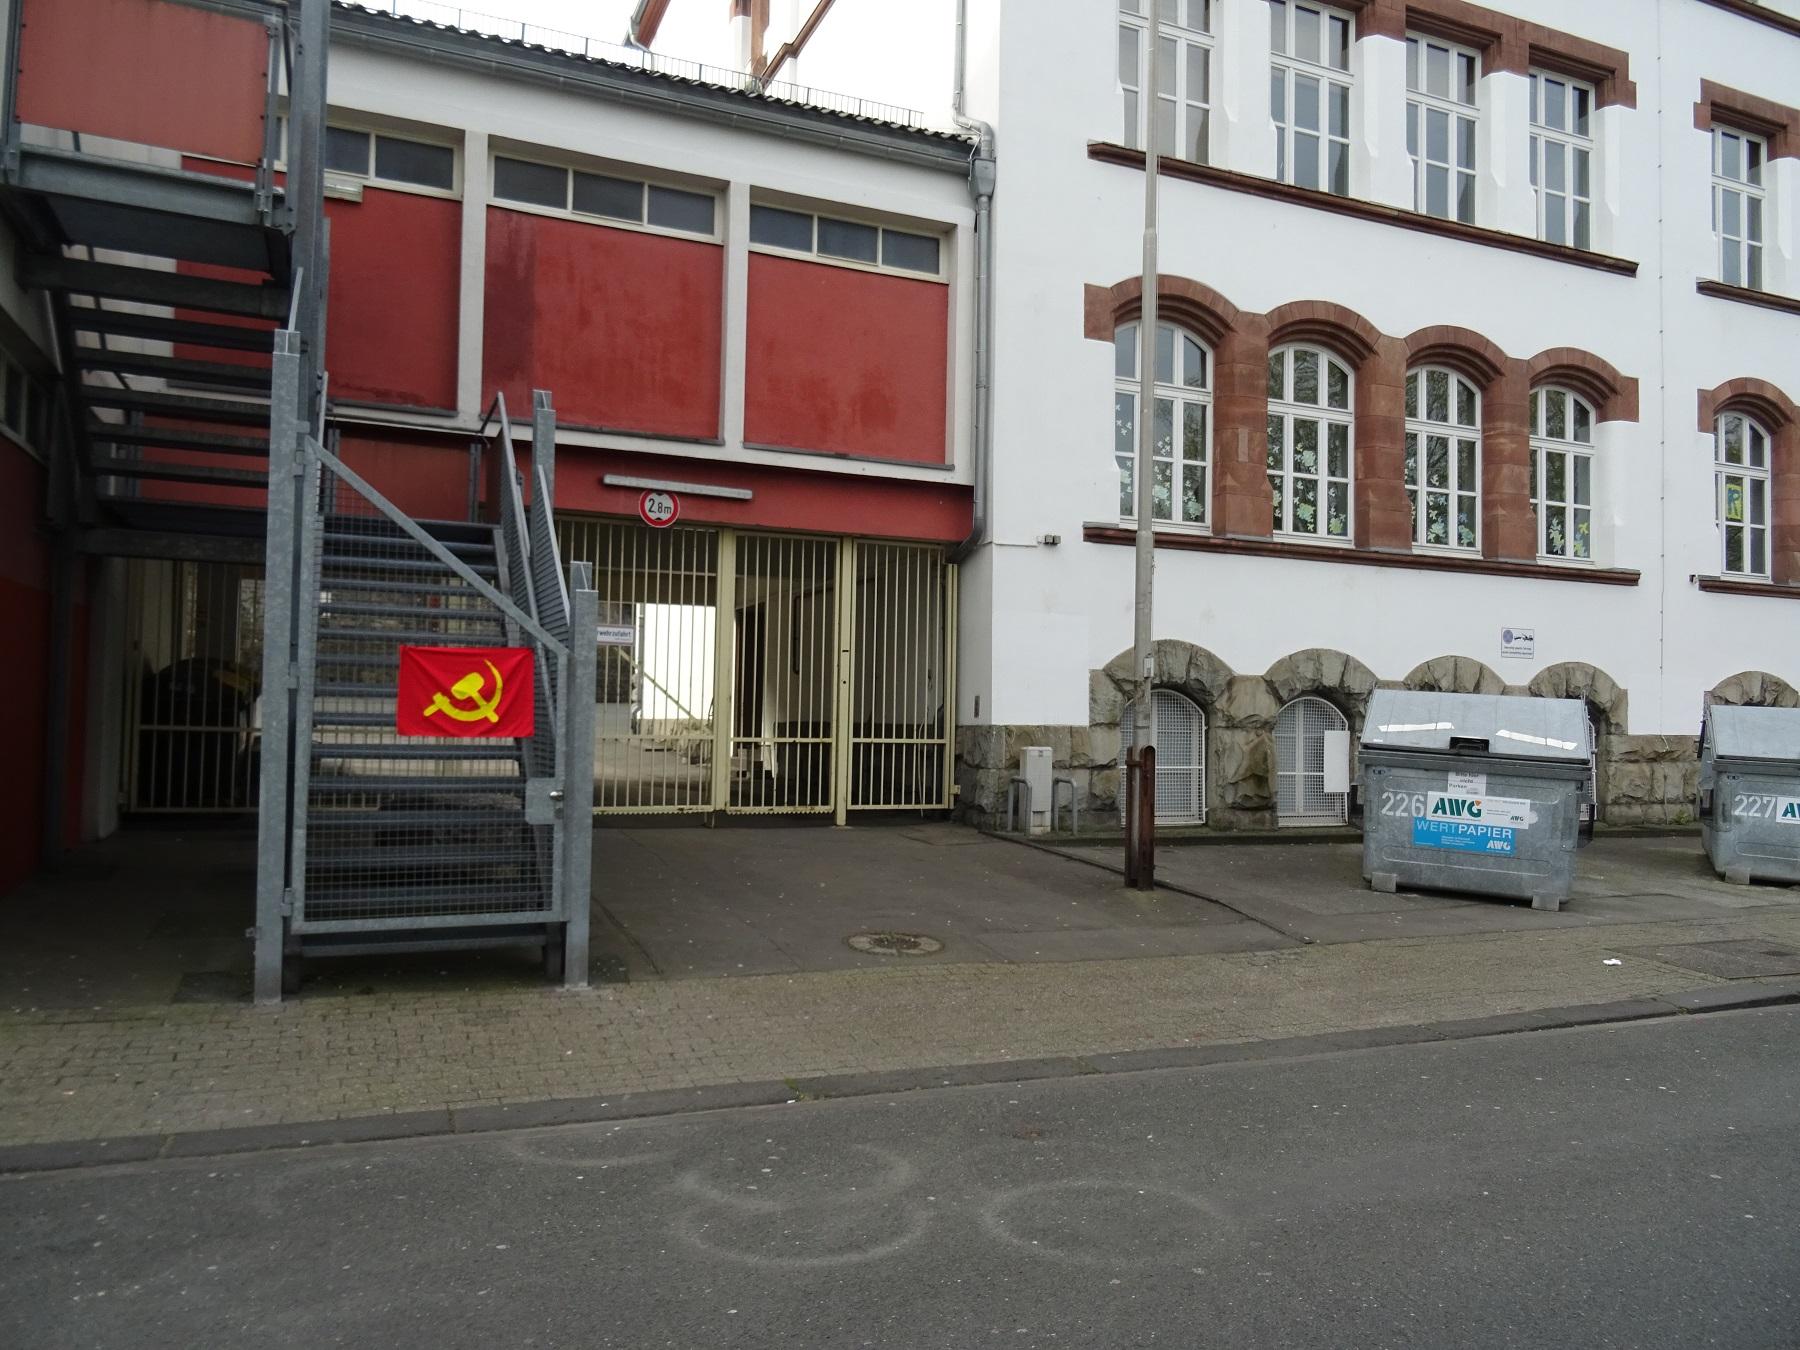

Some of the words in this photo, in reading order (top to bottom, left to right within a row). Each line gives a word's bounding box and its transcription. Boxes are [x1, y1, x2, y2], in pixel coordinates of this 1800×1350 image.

[1381, 791, 1424, 817] 226
[1432, 797, 1482, 818] AWG
[1735, 795, 1776, 818] 227
[1416, 820, 1512, 839] WERTPAPIER
[1486, 840, 1511, 851] AWG
